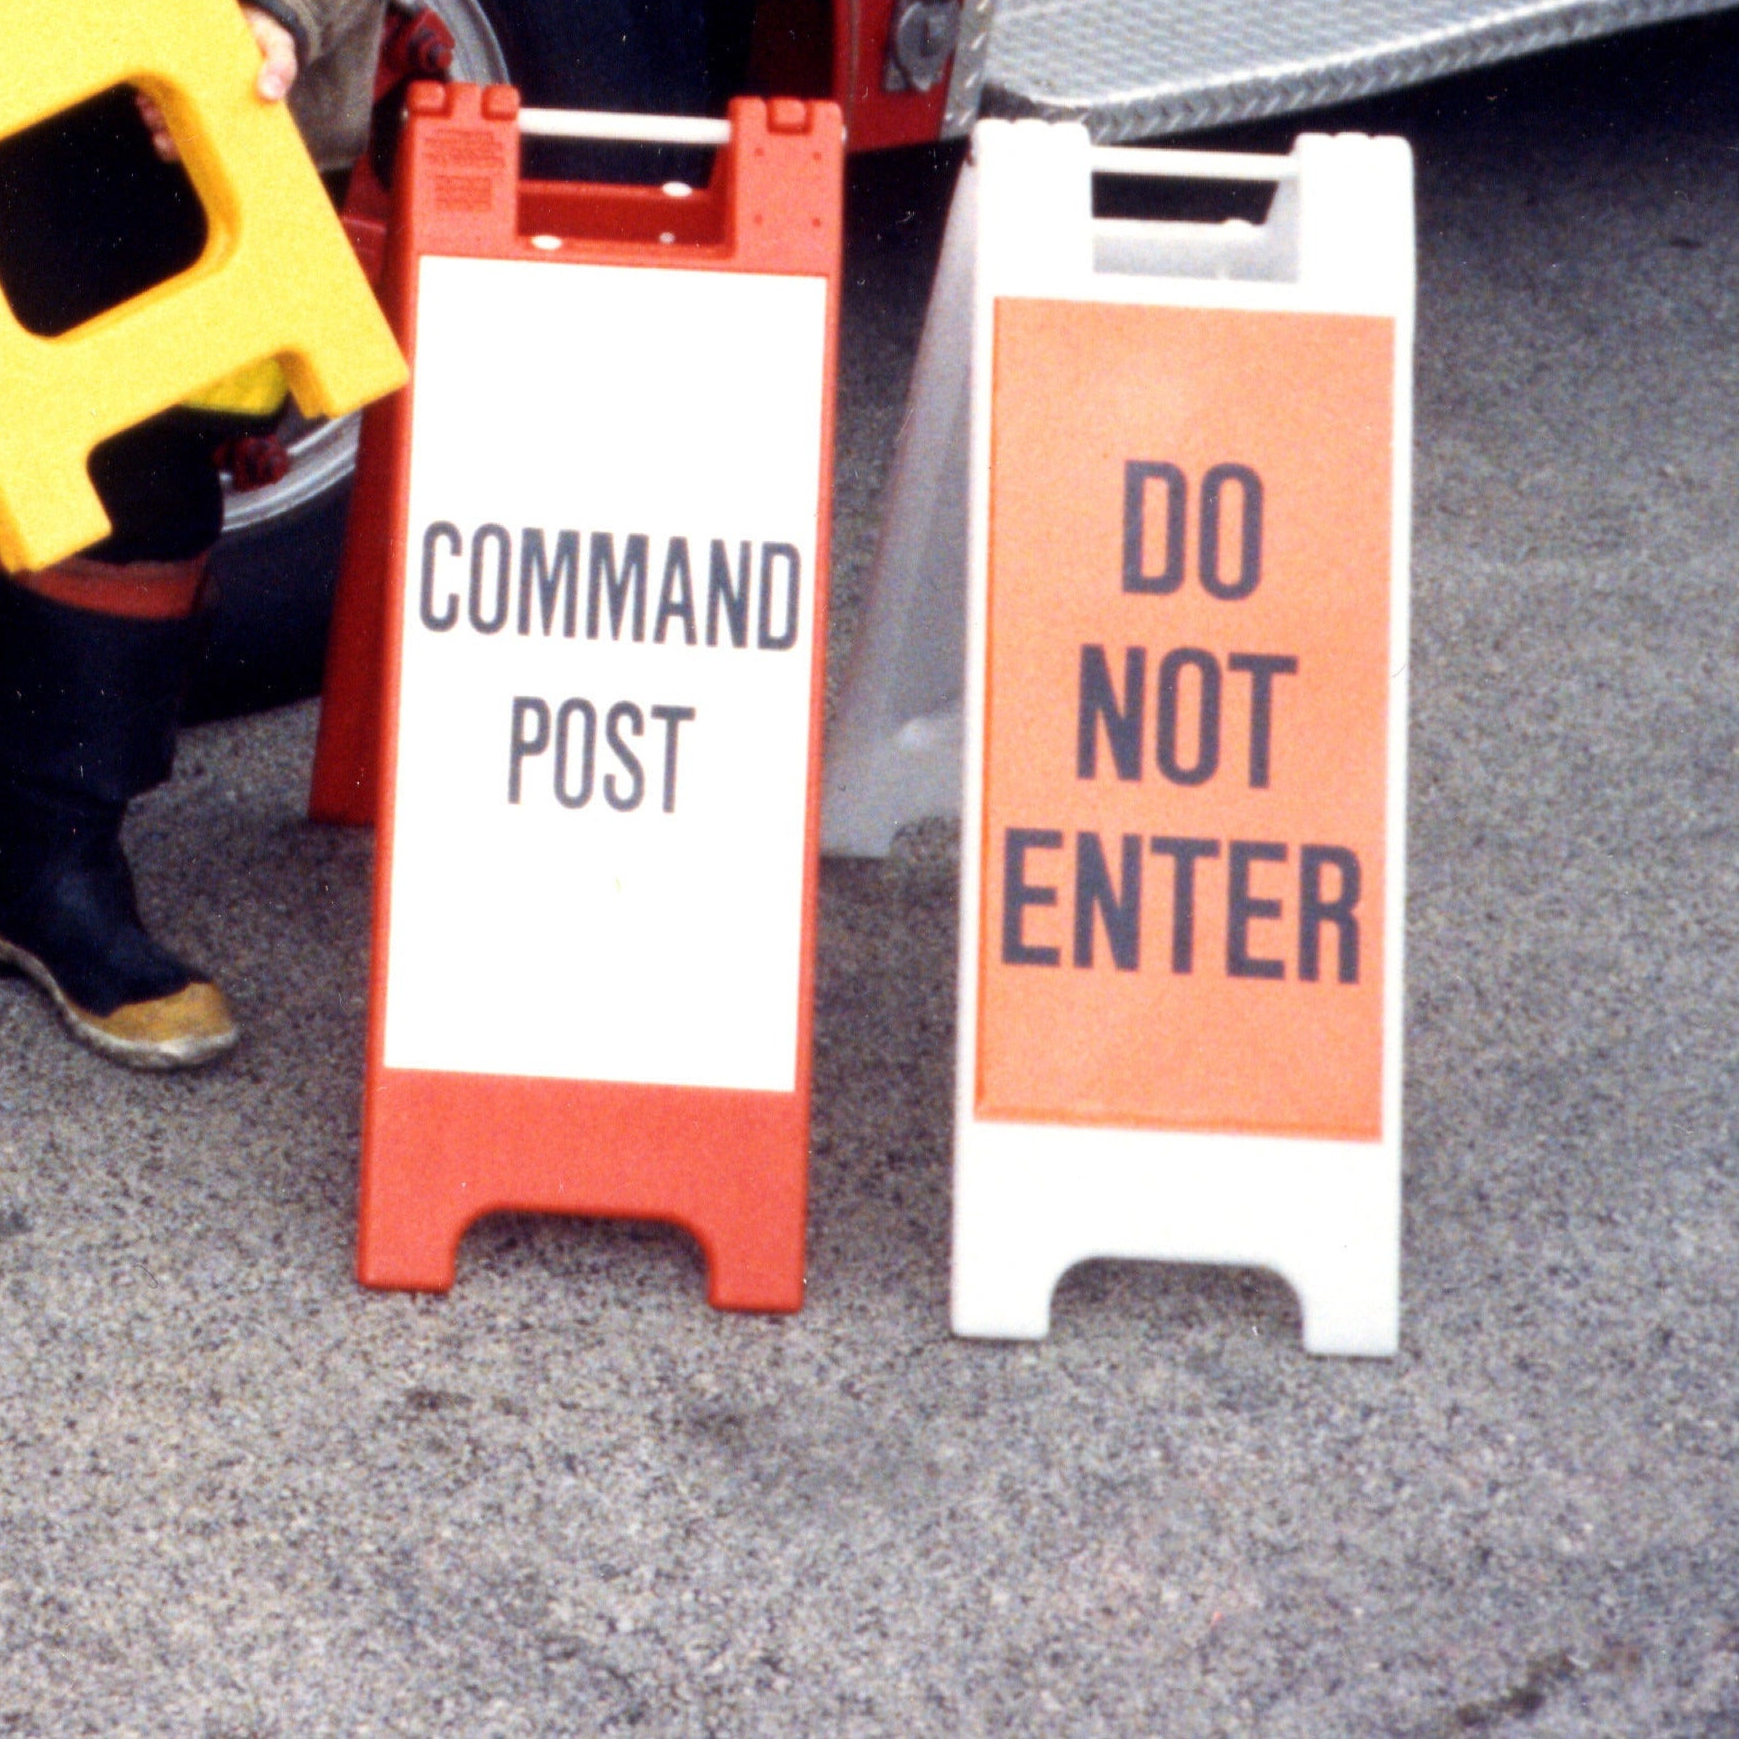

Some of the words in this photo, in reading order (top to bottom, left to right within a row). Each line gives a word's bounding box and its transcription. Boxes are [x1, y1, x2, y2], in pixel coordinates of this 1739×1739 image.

[419, 519, 802, 652] COMMAND
[1121, 458, 1265, 602] DO
[507, 695, 696, 814] POST
[1076, 643, 1300, 790] NOT
[1001, 827, 1363, 985] ENTER
